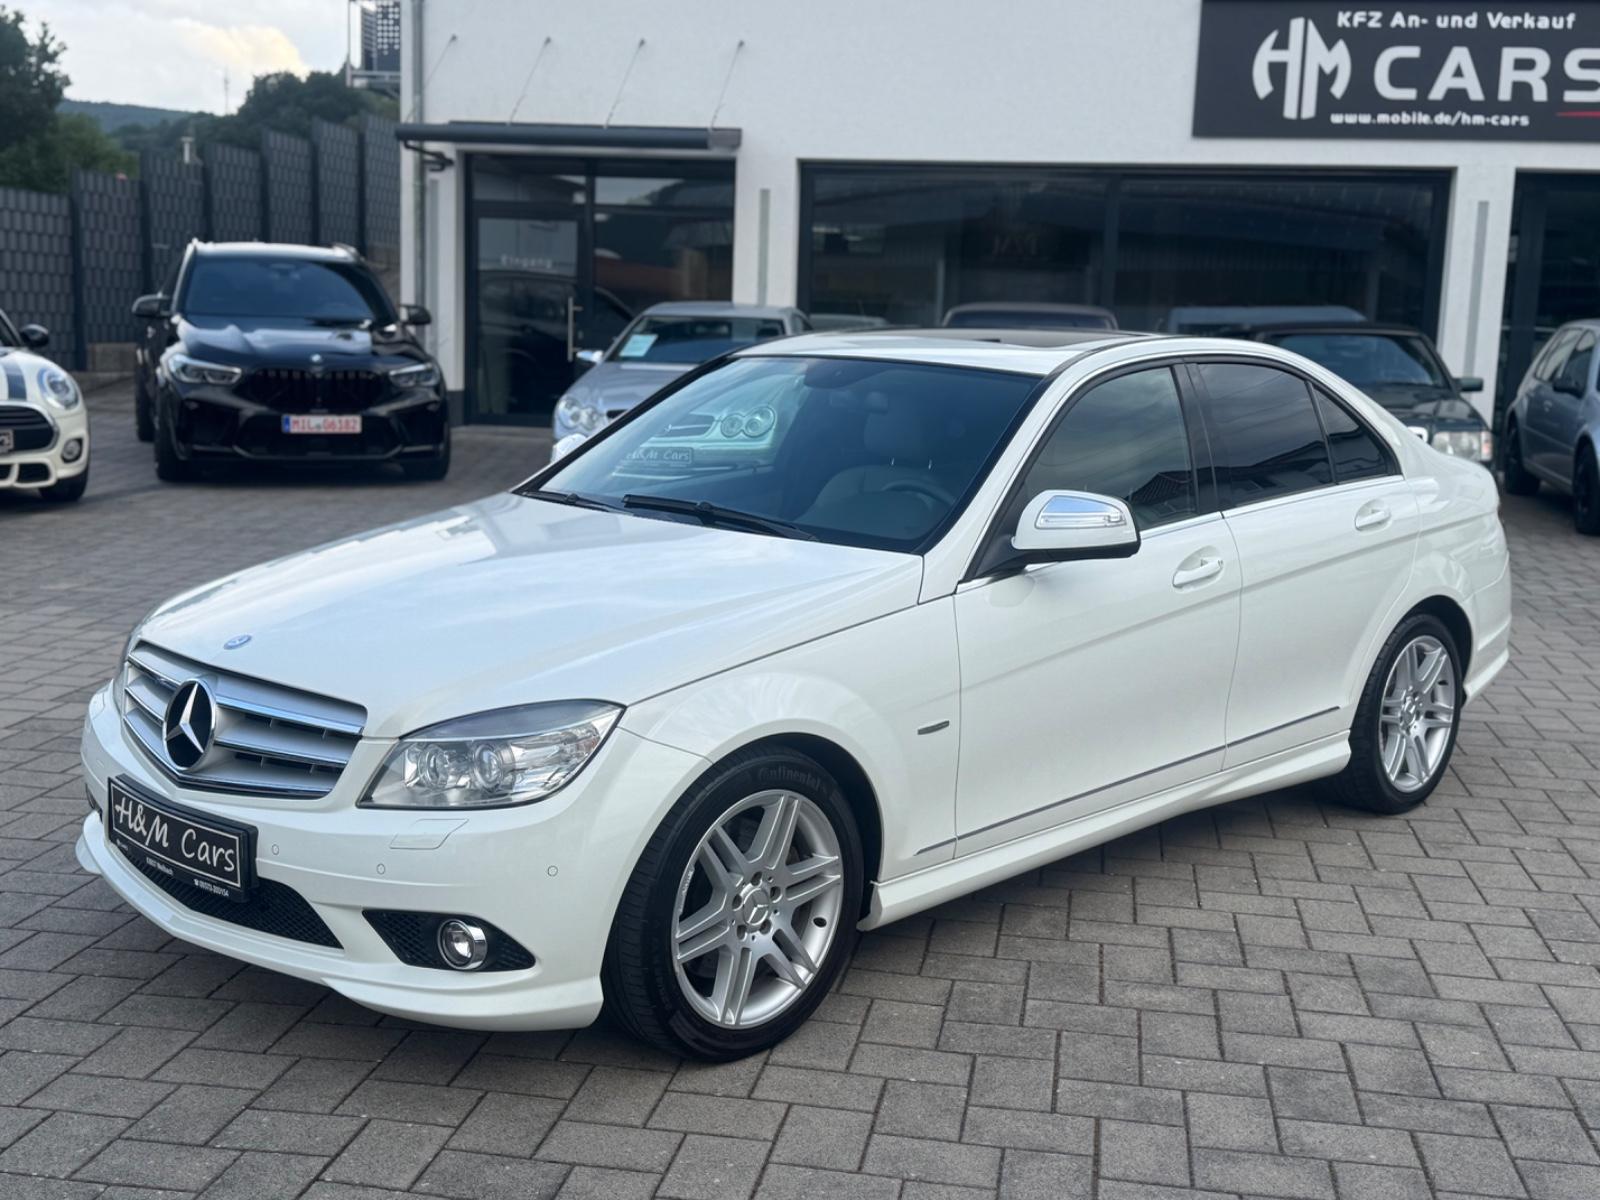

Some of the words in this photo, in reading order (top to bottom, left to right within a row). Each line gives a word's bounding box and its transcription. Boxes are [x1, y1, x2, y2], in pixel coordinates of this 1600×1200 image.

[1337, 11, 1382, 28] KFZ
[1390, 12, 1428, 28] An-
[1436, 12, 1478, 28] und
[1487, 12, 1576, 29] Verkauf
[1373, 46, 1600, 102] CARS
[1330, 111, 1530, 126] www.mobile.de/hm-cars
[663, 449, 689, 460] Cars
[115, 797, 169, 848] H&M
[181, 828, 235, 872] Cars
